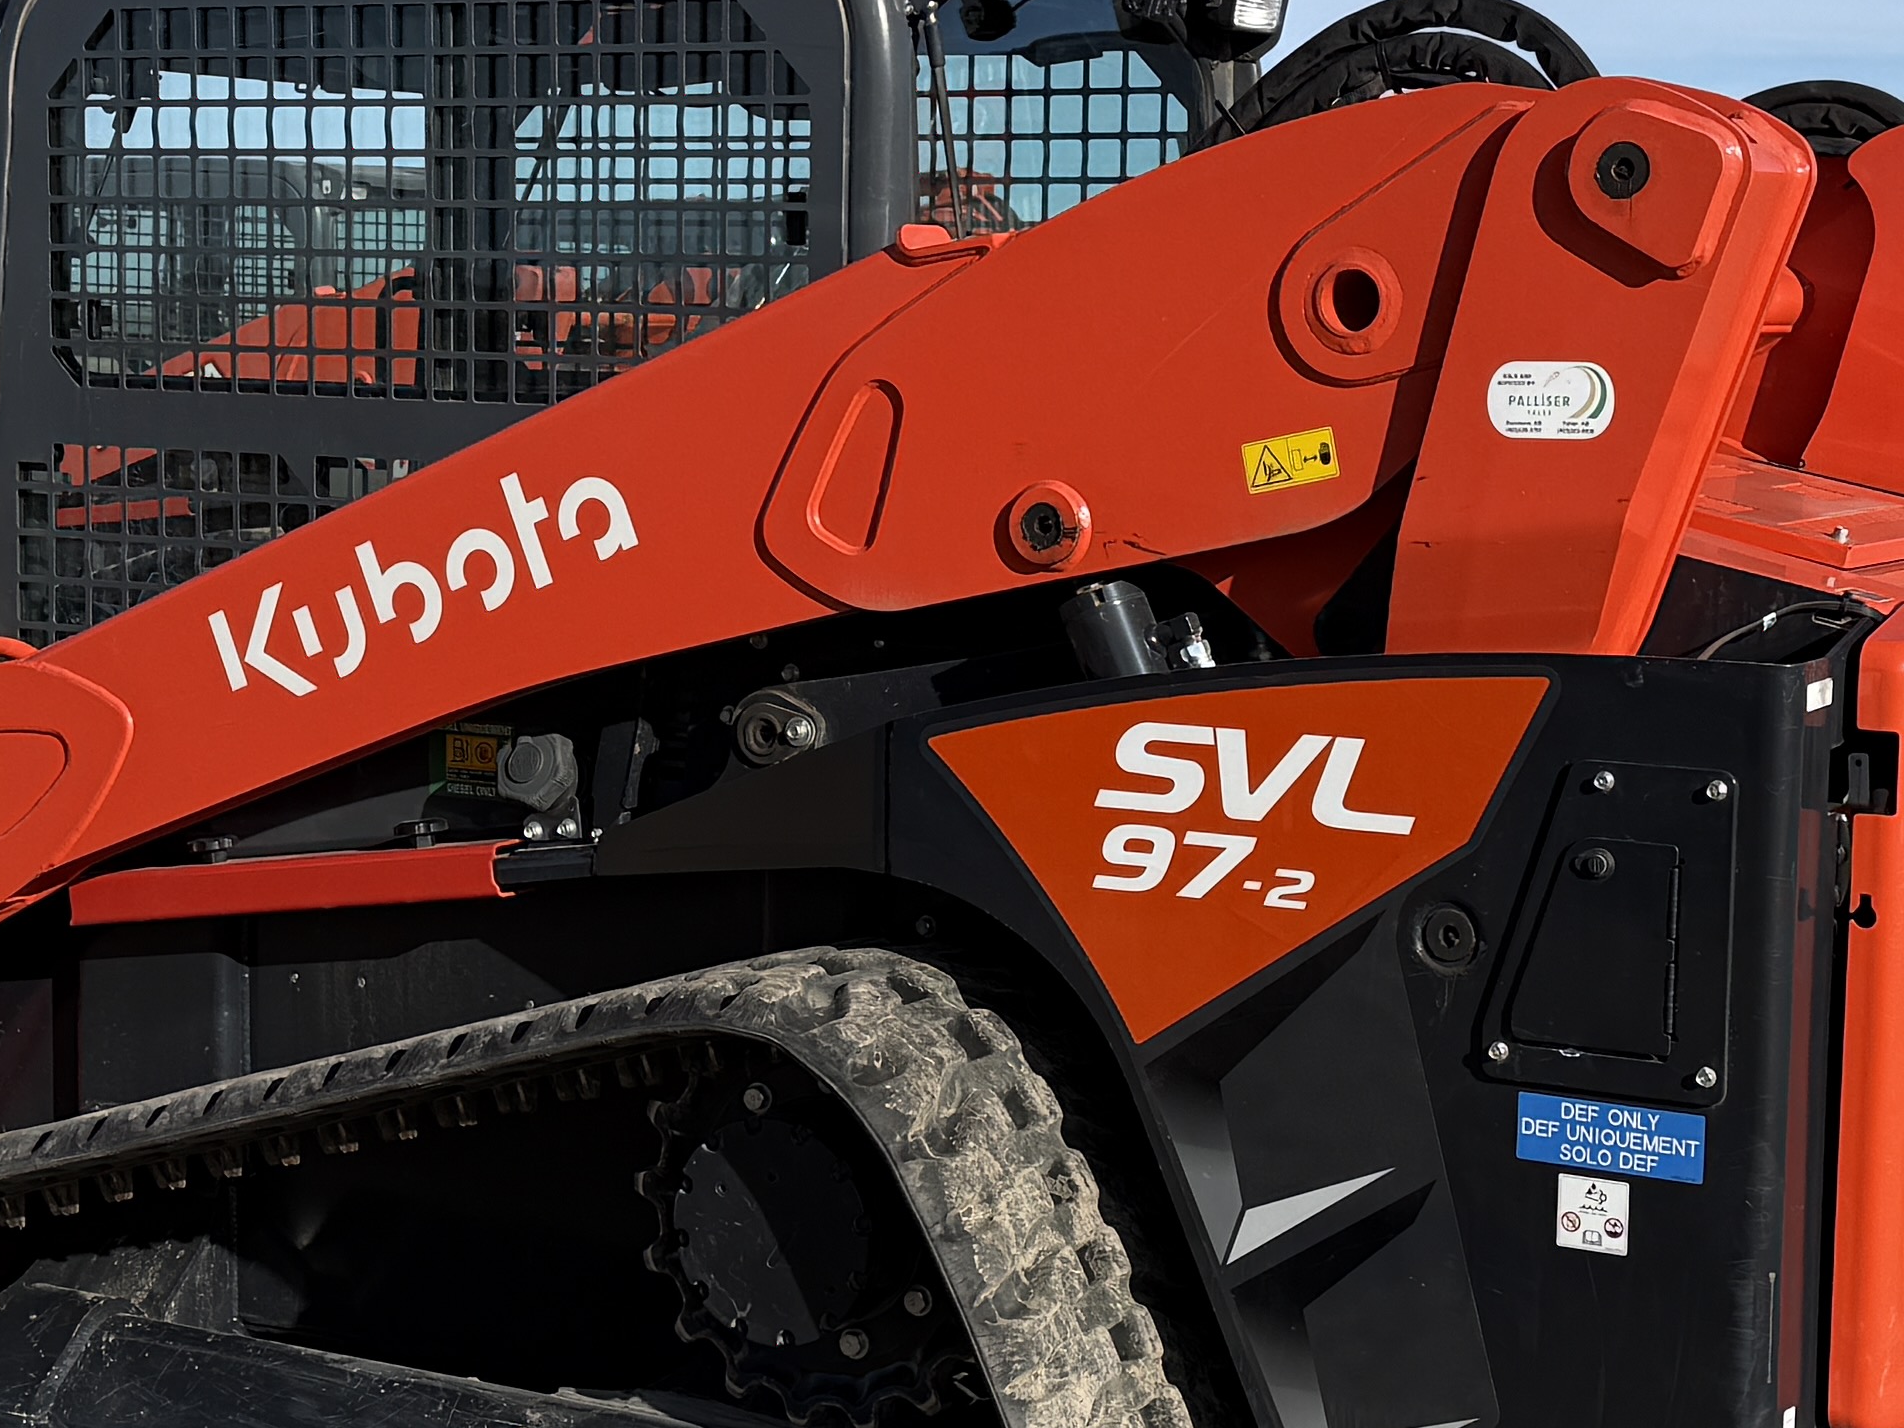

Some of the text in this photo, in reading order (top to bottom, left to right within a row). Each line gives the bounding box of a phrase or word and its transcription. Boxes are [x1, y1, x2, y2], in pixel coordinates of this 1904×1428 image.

[1508, 393, 1571, 407] PALLISER
[208, 472, 639, 697] Kubota
[1094, 722, 1416, 835] SVL
[1092, 824, 1315, 910] 97-2
[1561, 1102, 1660, 1131] DEF ONLY
[1521, 1117, 1700, 1158] DEF UNIQUEMENT
[1560, 1143, 1659, 1173] SOLO DEF
